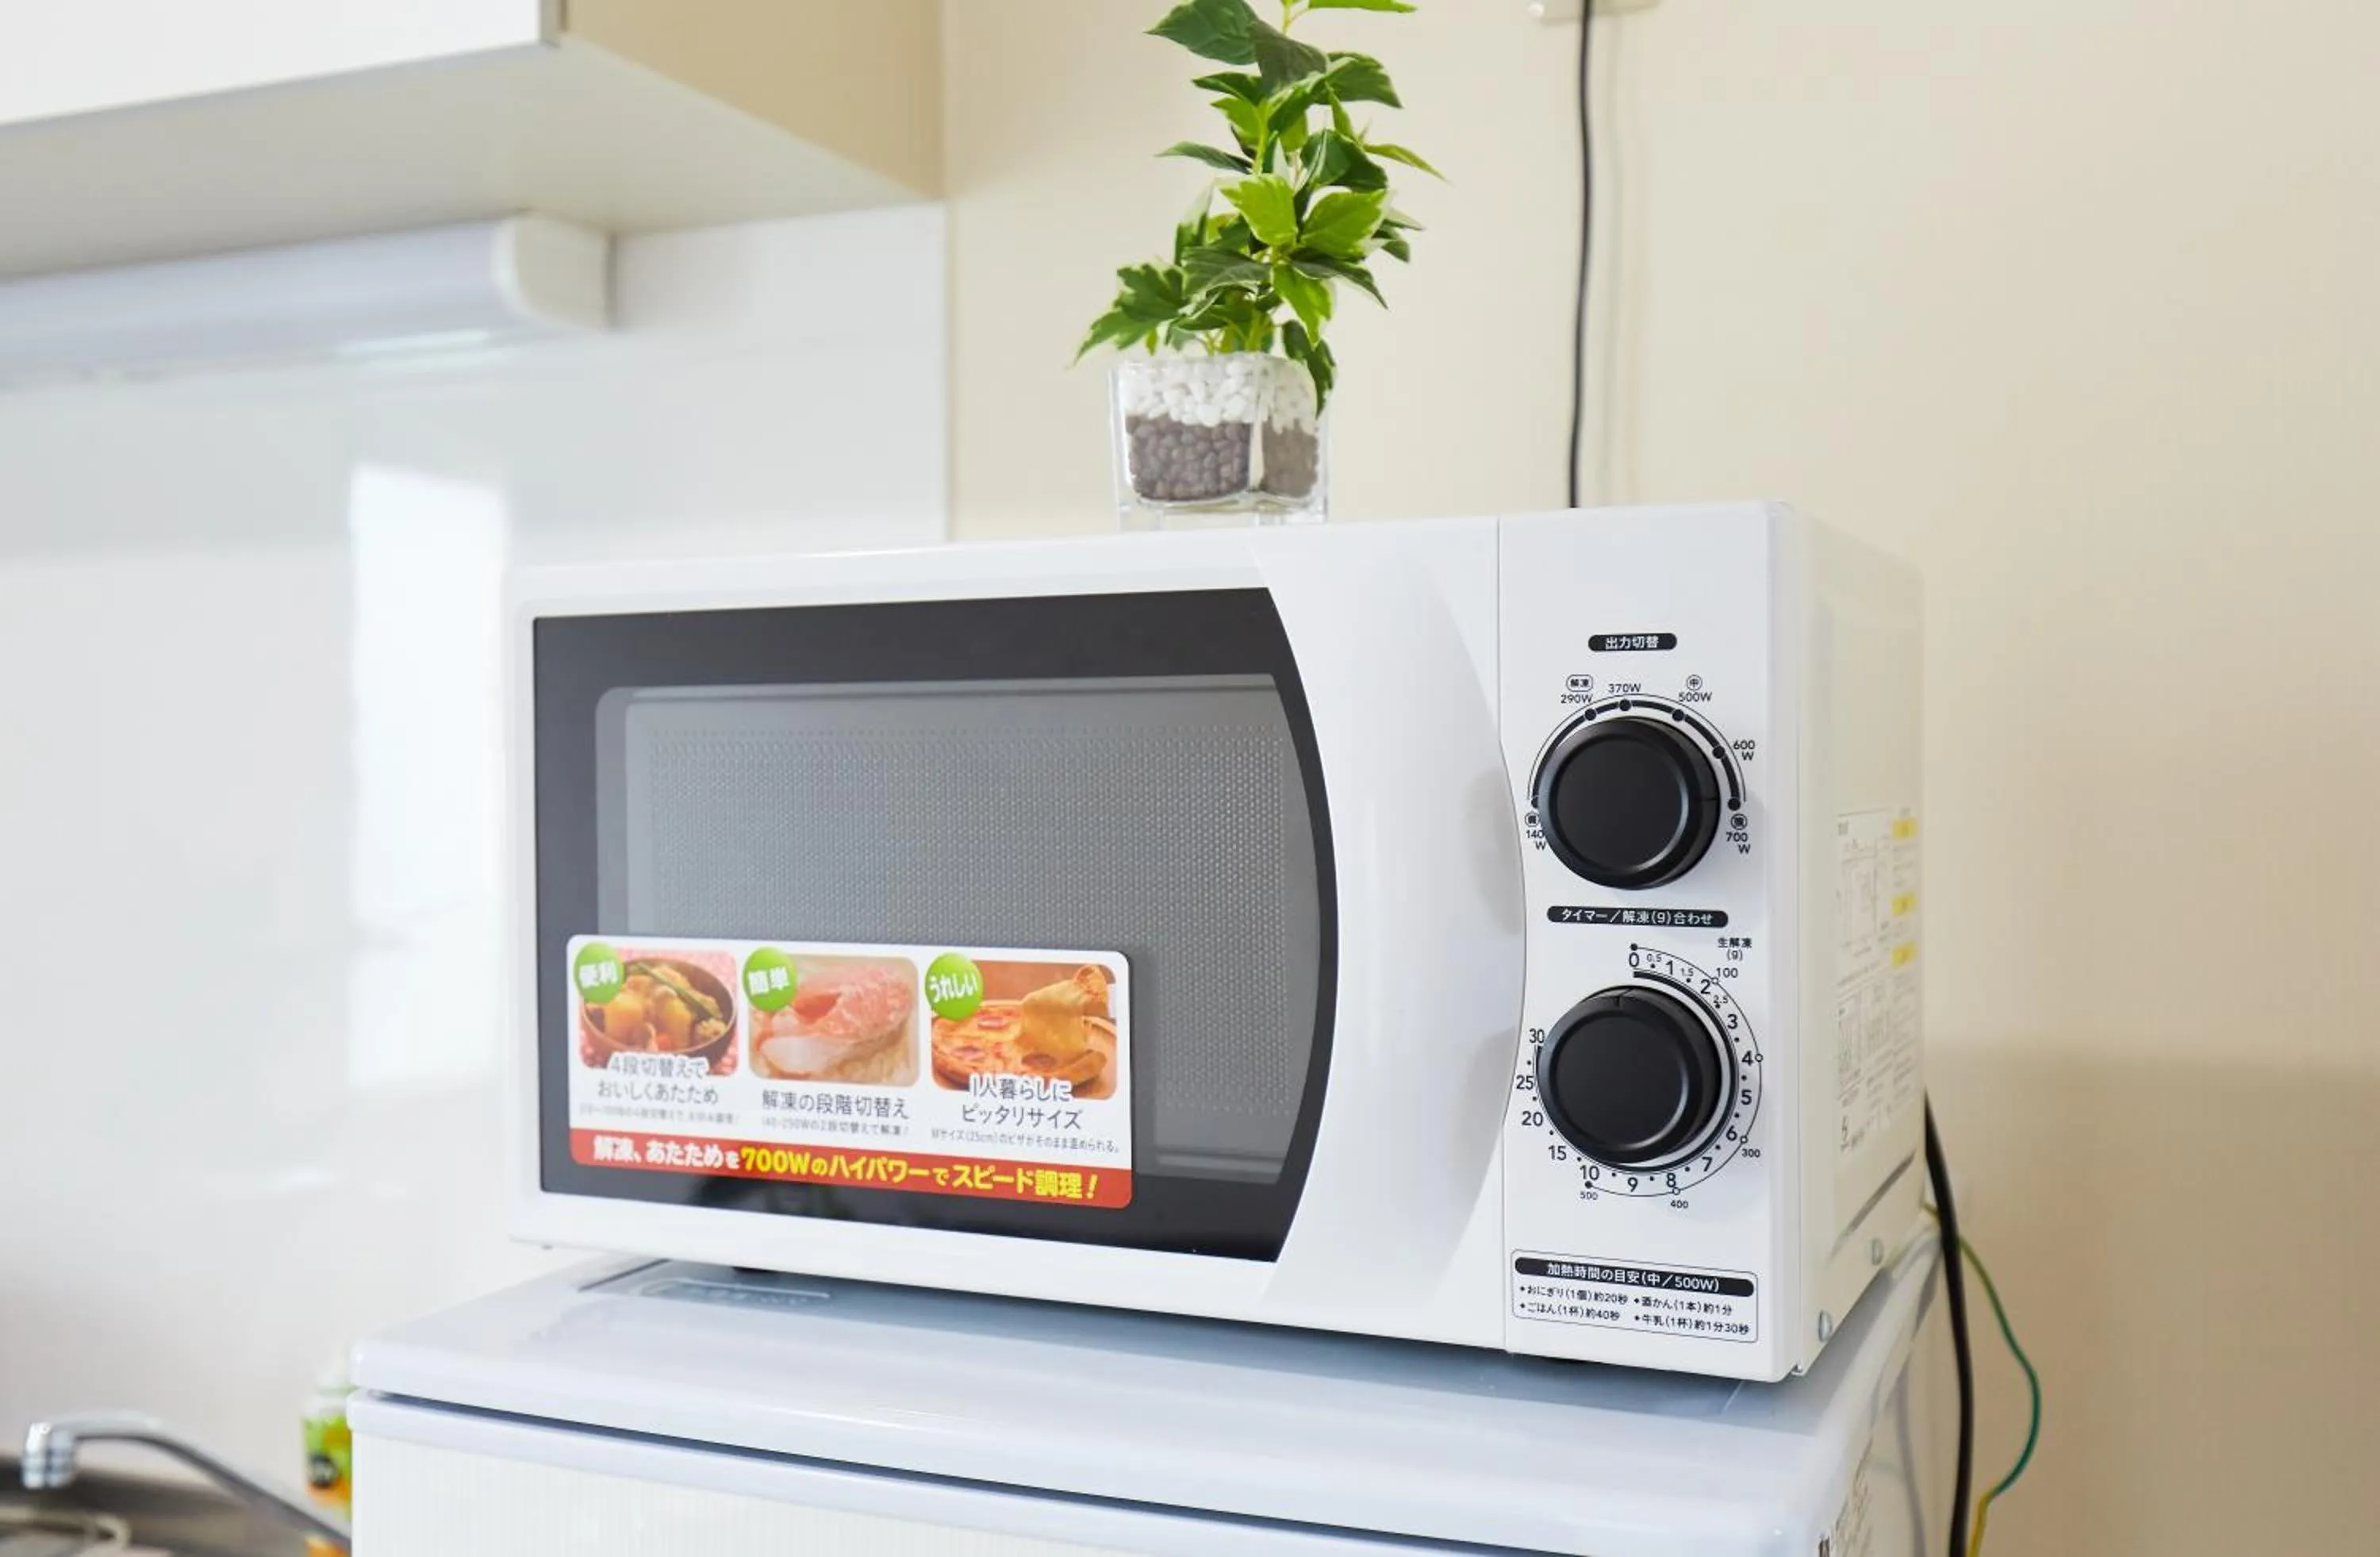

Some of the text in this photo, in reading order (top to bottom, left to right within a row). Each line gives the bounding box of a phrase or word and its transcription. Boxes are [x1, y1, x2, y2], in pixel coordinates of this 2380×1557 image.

[1606, 636, 1659, 649] 出力切替
[1608, 683, 1641, 693] 370W
[1561, 694, 1593, 704] 290W
[1679, 692, 1712, 702] 500W
[1733, 740, 1755, 750] 600
[1742, 752, 1753, 761] W
[1526, 829, 1545, 839] 140
[1726, 832, 1748, 842] 700
[1536, 841, 1546, 850] W
[1738, 844, 1751, 855] W
[1718, 937, 1752, 949] 生解凍
[1629, 952, 1640, 967] 0
[1647, 953, 1662, 963] 0.5
[579, 961, 617, 988] 便利
[1666, 960, 1673, 975] 1
[1681, 967, 1694, 977] 1.5
[1716, 967, 1738, 978] 100
[749, 967, 789, 994] 簡単
[1701, 979, 1711, 994] 2
[930, 974, 978, 1003] うれしい
[1713, 995, 1729, 1004] 2.5
[1728, 1013, 1738, 1029] 3
[1529, 1028, 1545, 1044] 30
[1741, 1050, 1753, 1066] 4
[610, 1055, 706, 1078] 4段切替えで
[972, 1076, 1071, 1101] 1人暮らしに
[1516, 1075, 1534, 1090] 25
[597, 1079, 719, 1104] おいしくあたため
[1741, 1090, 1752, 1105] 5
[762, 1090, 909, 1120] 解凍の段階切替え
[1522, 1111, 1543, 1127] 20
[1726, 1125, 1737, 1141] 6
[1548, 1146, 1566, 1161] 15
[1742, 1148, 1760, 1158] 300
[1702, 1156, 1713, 1172] 7
[1580, 1165, 1600, 1180] 10
[1627, 1177, 1638, 1192] 9
[1667, 1173, 1676, 1188] 8
[1580, 1191, 1599, 1201] 500
[1670, 1199, 1689, 1209] 400
